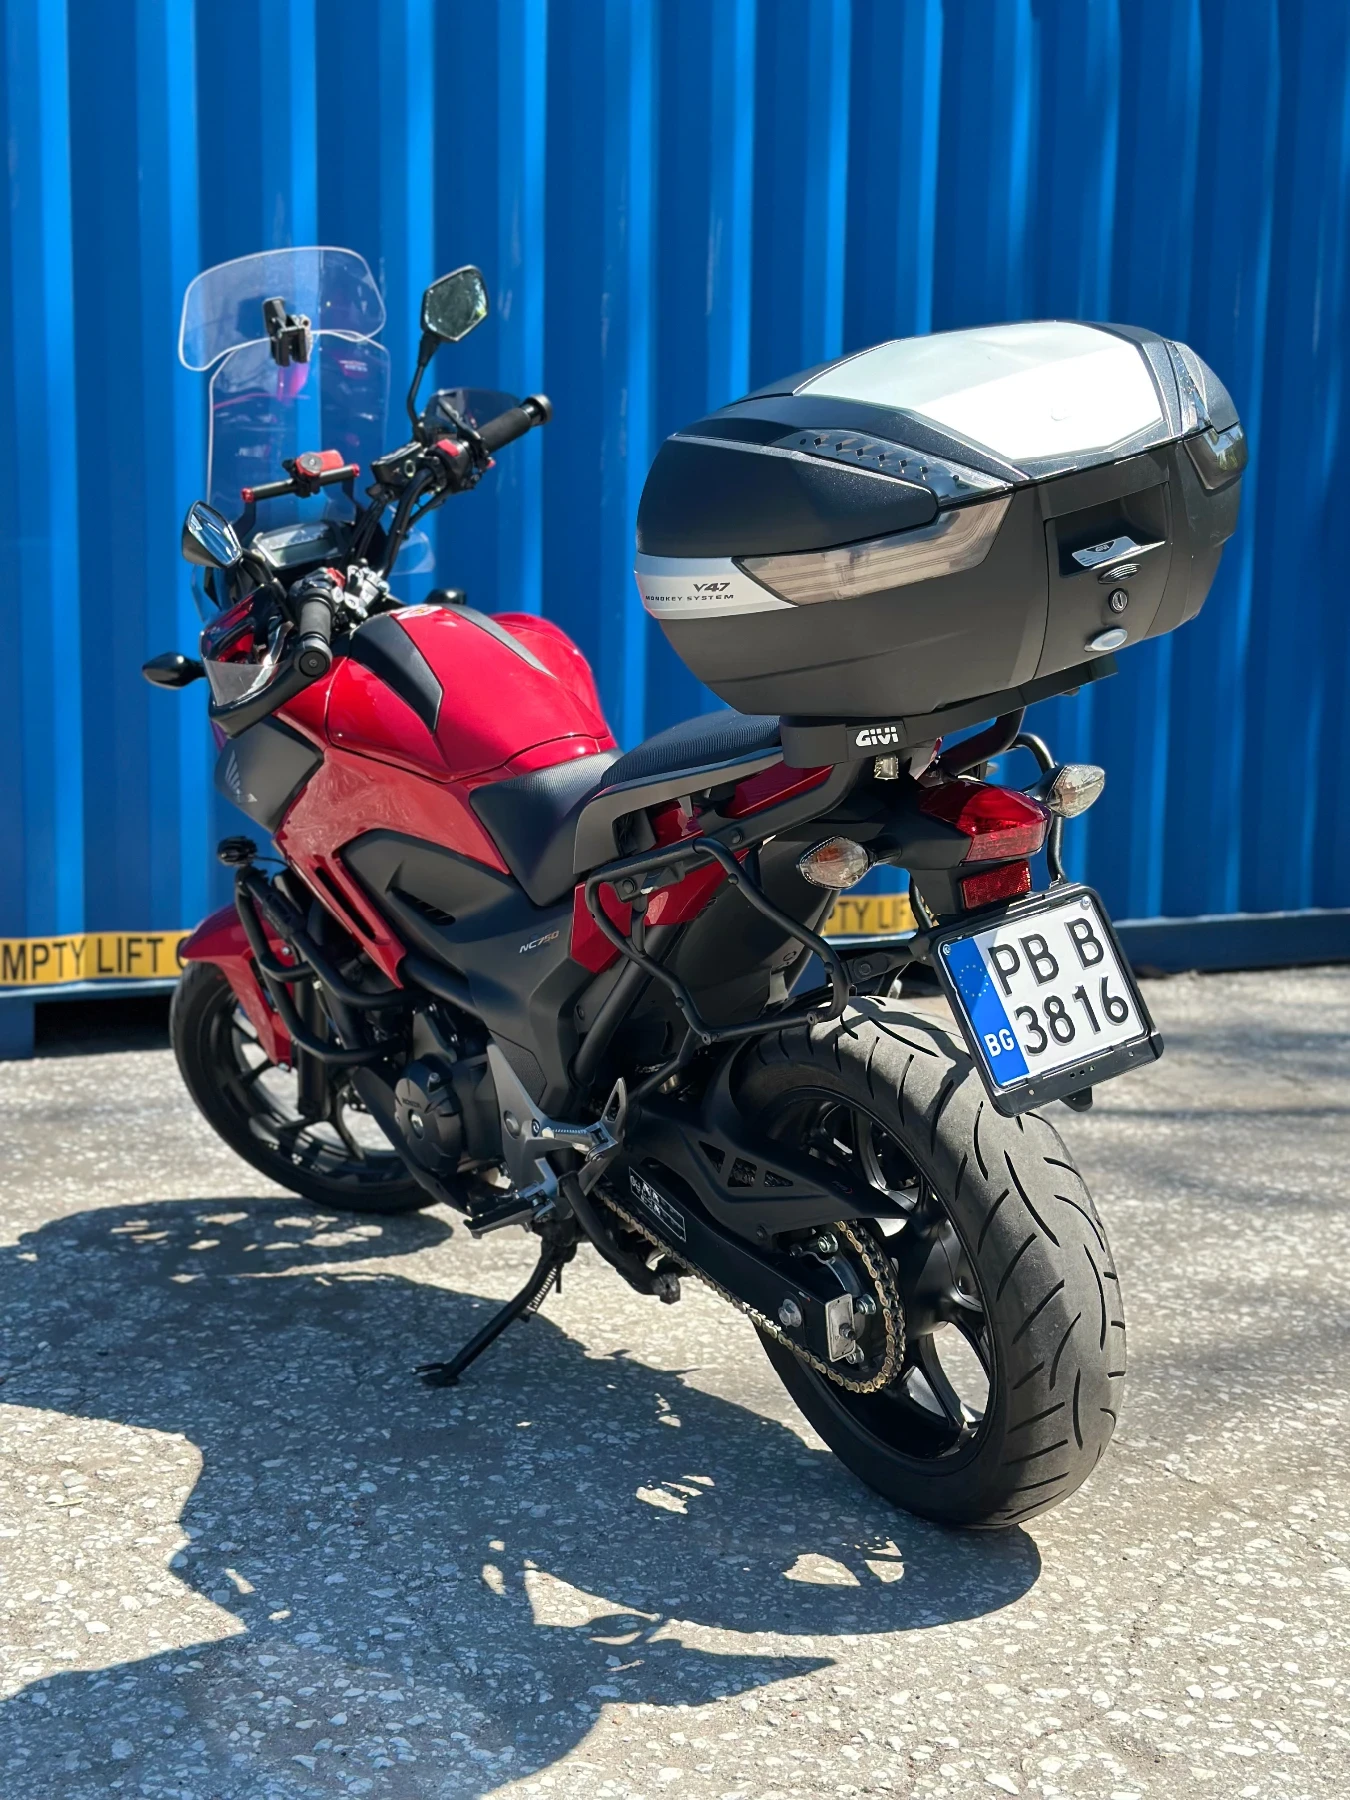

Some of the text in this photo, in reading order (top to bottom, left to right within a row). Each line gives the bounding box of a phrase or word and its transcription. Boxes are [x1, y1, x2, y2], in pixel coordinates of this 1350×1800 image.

[693, 582, 731, 592] V47
[855, 726, 899, 747] GIVI
[97, 937, 164, 975] LIFT
[519, 930, 560, 954] NC750
[988, 917, 1105, 997] PB B
[1014, 976, 1129, 1057] 3816
[983, 1028, 1015, 1057] BG
